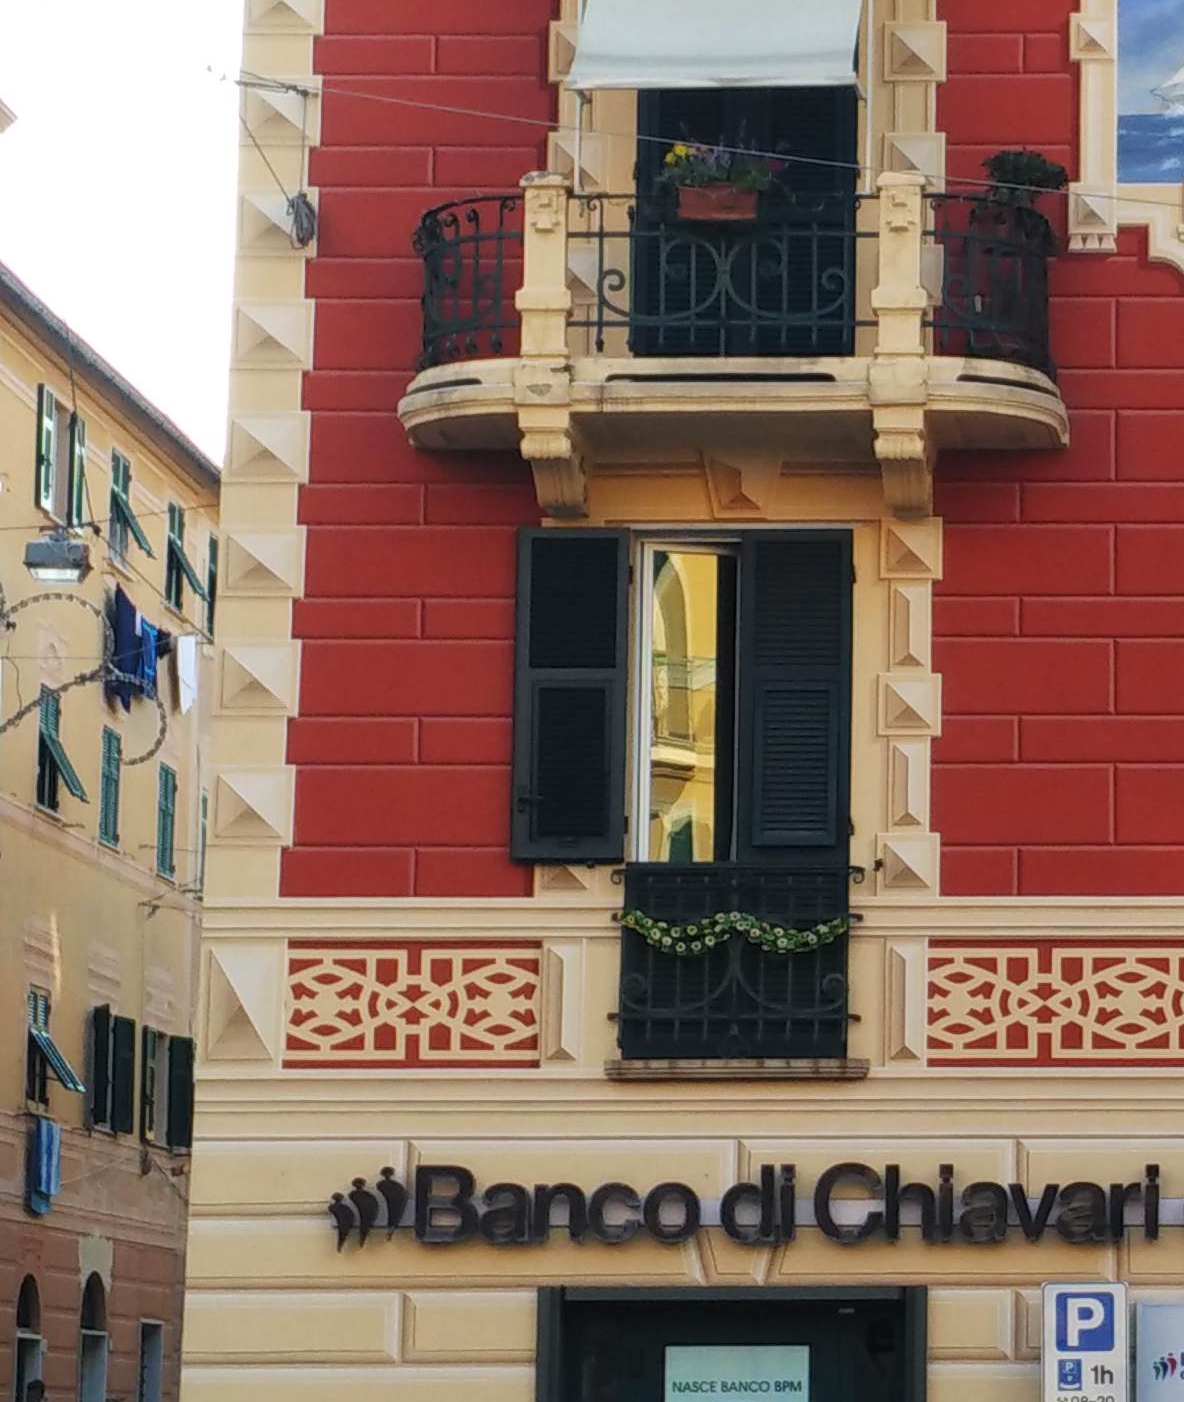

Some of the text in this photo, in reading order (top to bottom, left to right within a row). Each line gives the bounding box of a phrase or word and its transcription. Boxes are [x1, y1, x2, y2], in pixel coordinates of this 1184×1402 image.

[413, 1163, 702, 1245] Banco
[720, 1163, 796, 1245] di
[813, 1161, 1161, 1245] Chiavari
[1066, 1298, 1105, 1347] P
[672, 1380, 803, 1393] NASCE BANCO BPM
[1090, 1364, 1114, 1385] 1h
